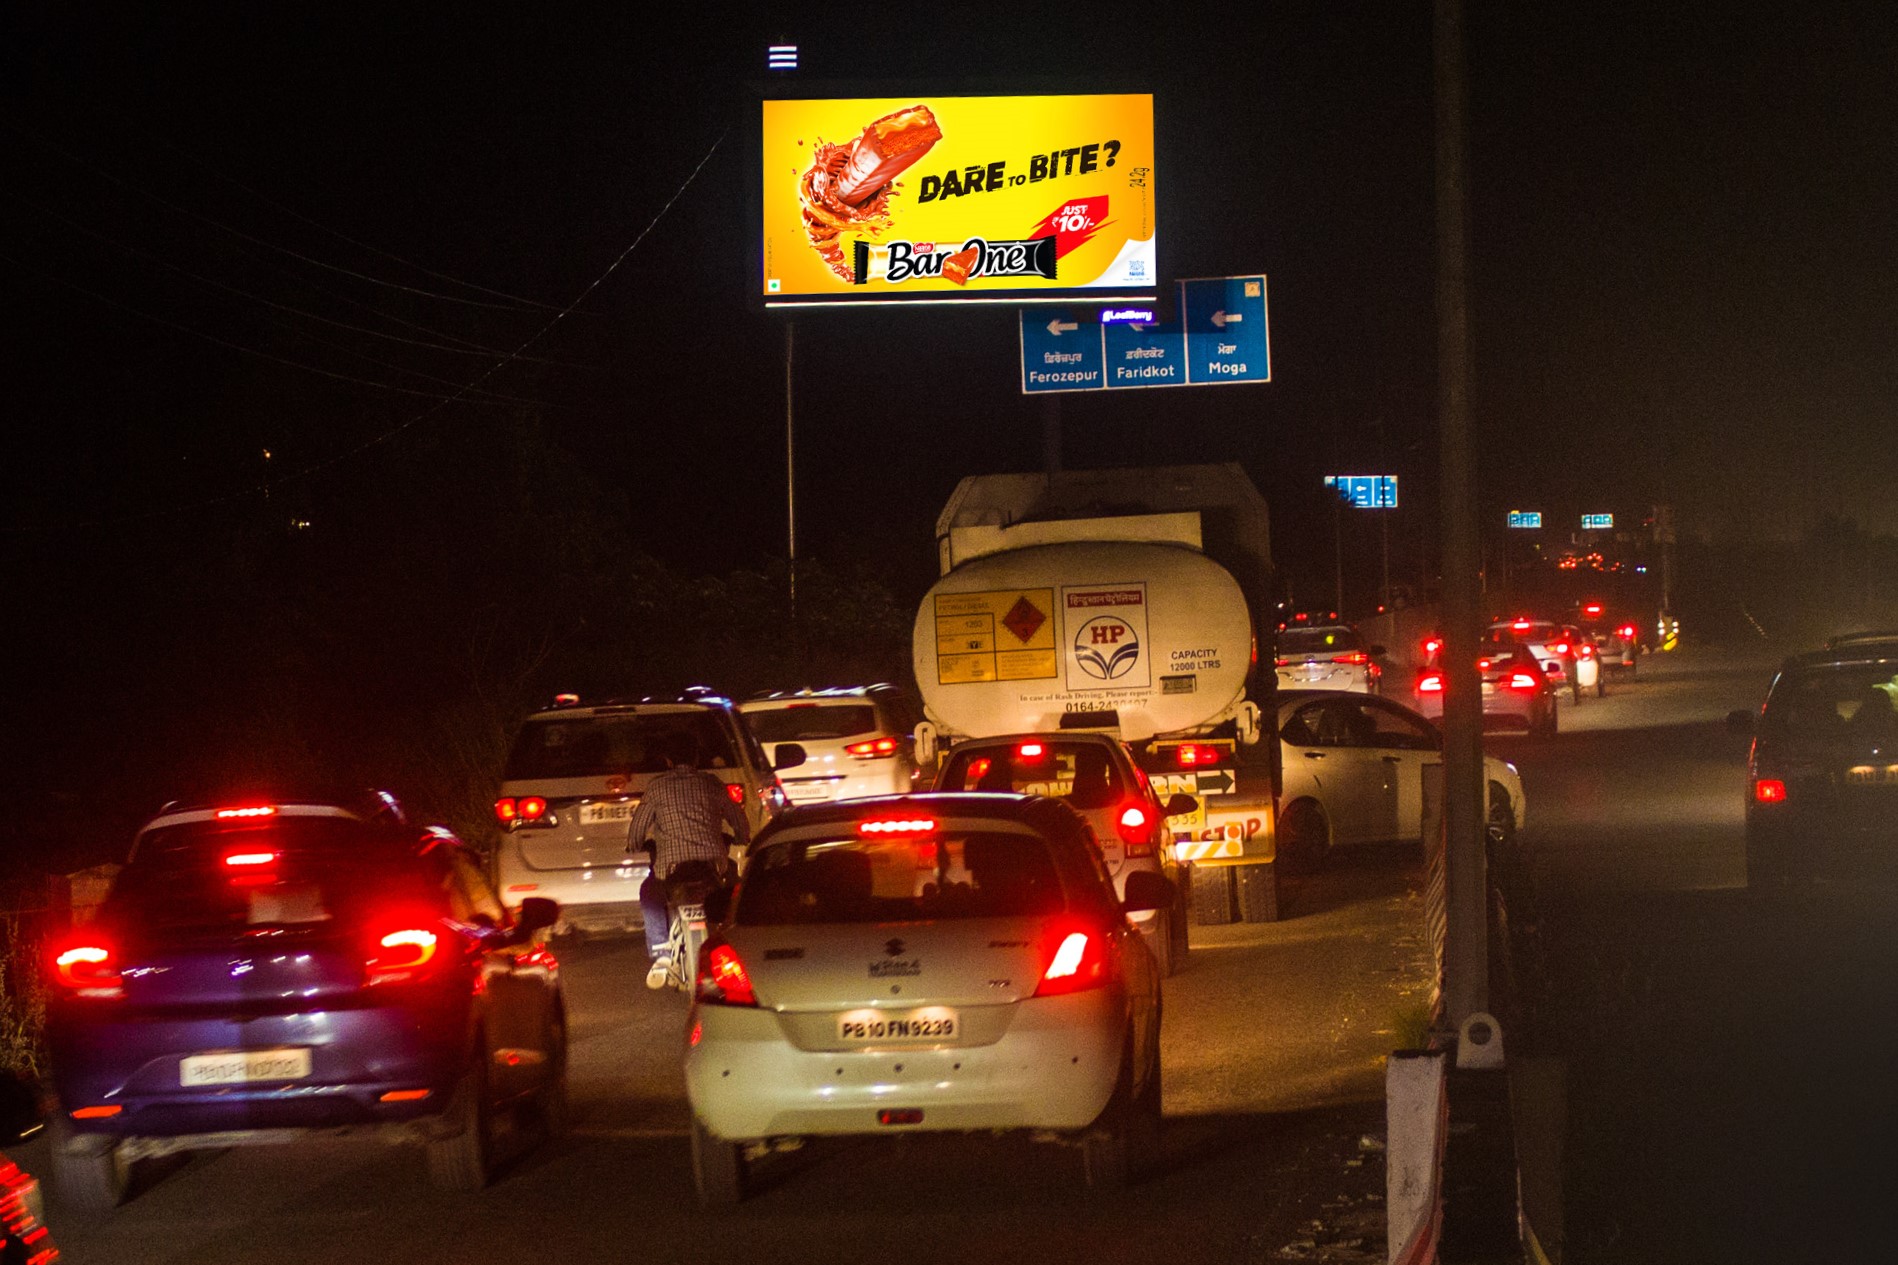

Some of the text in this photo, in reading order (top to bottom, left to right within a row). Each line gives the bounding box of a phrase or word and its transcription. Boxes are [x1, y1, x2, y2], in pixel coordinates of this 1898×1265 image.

[918, 161, 1006, 204] DARE
[1008, 174, 1027, 188] TO
[1061, 204, 1089, 216] JUST
[1117, 365, 1174, 379] Faridkot
[1209, 362, 1247, 376] Moga
[1030, 371, 1098, 383] Ferozepur
[1091, 625, 1125, 644] HP
[1171, 649, 1218, 660] CAPACITY
[1170, 659, 1221, 672] 12000 LTRS
[1201, 817, 1262, 842] STP
